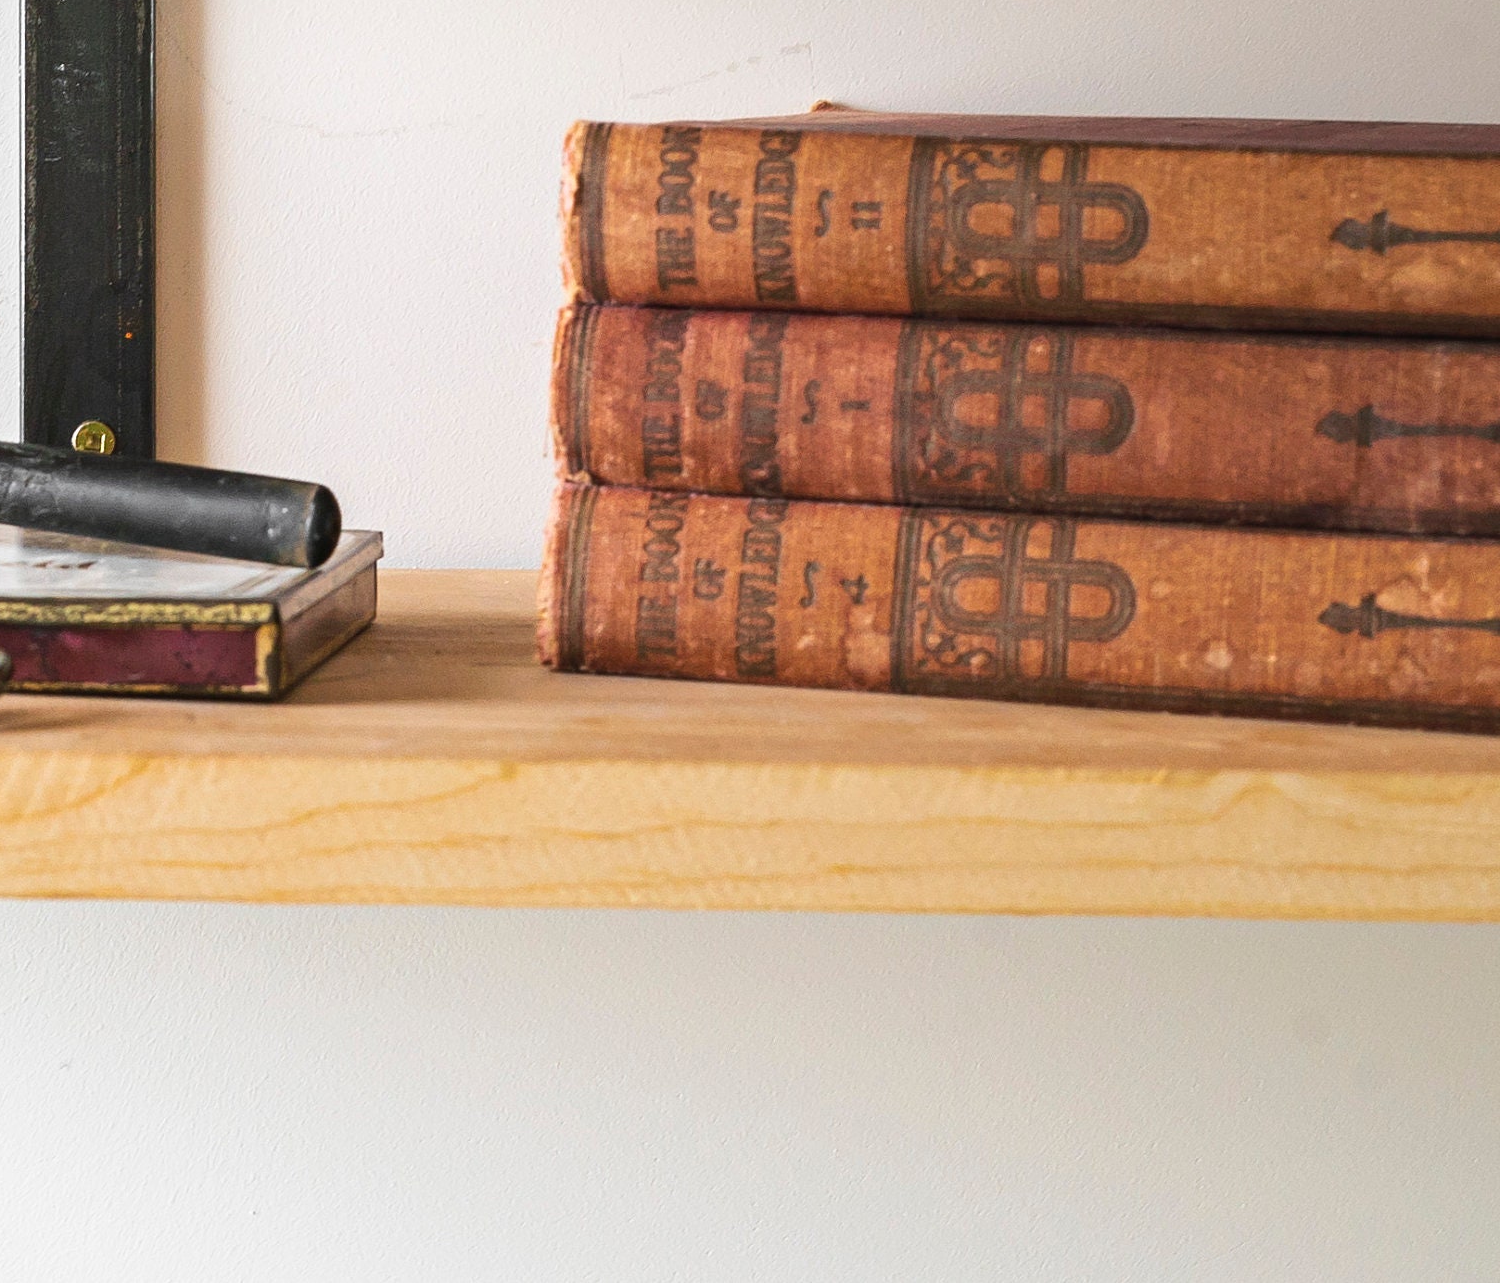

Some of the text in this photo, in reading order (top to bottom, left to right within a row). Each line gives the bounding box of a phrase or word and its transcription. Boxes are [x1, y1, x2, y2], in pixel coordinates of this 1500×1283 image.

[708, 190, 742, 234] OF
[752, 128, 802, 303] KNOWLEDG
[656, 225, 697, 292] THE
[693, 557, 727, 601] OF
[735, 497, 789, 677] KNOWLEDG
[839, 571, 870, 605] 4
[636, 593, 680, 662] THE
